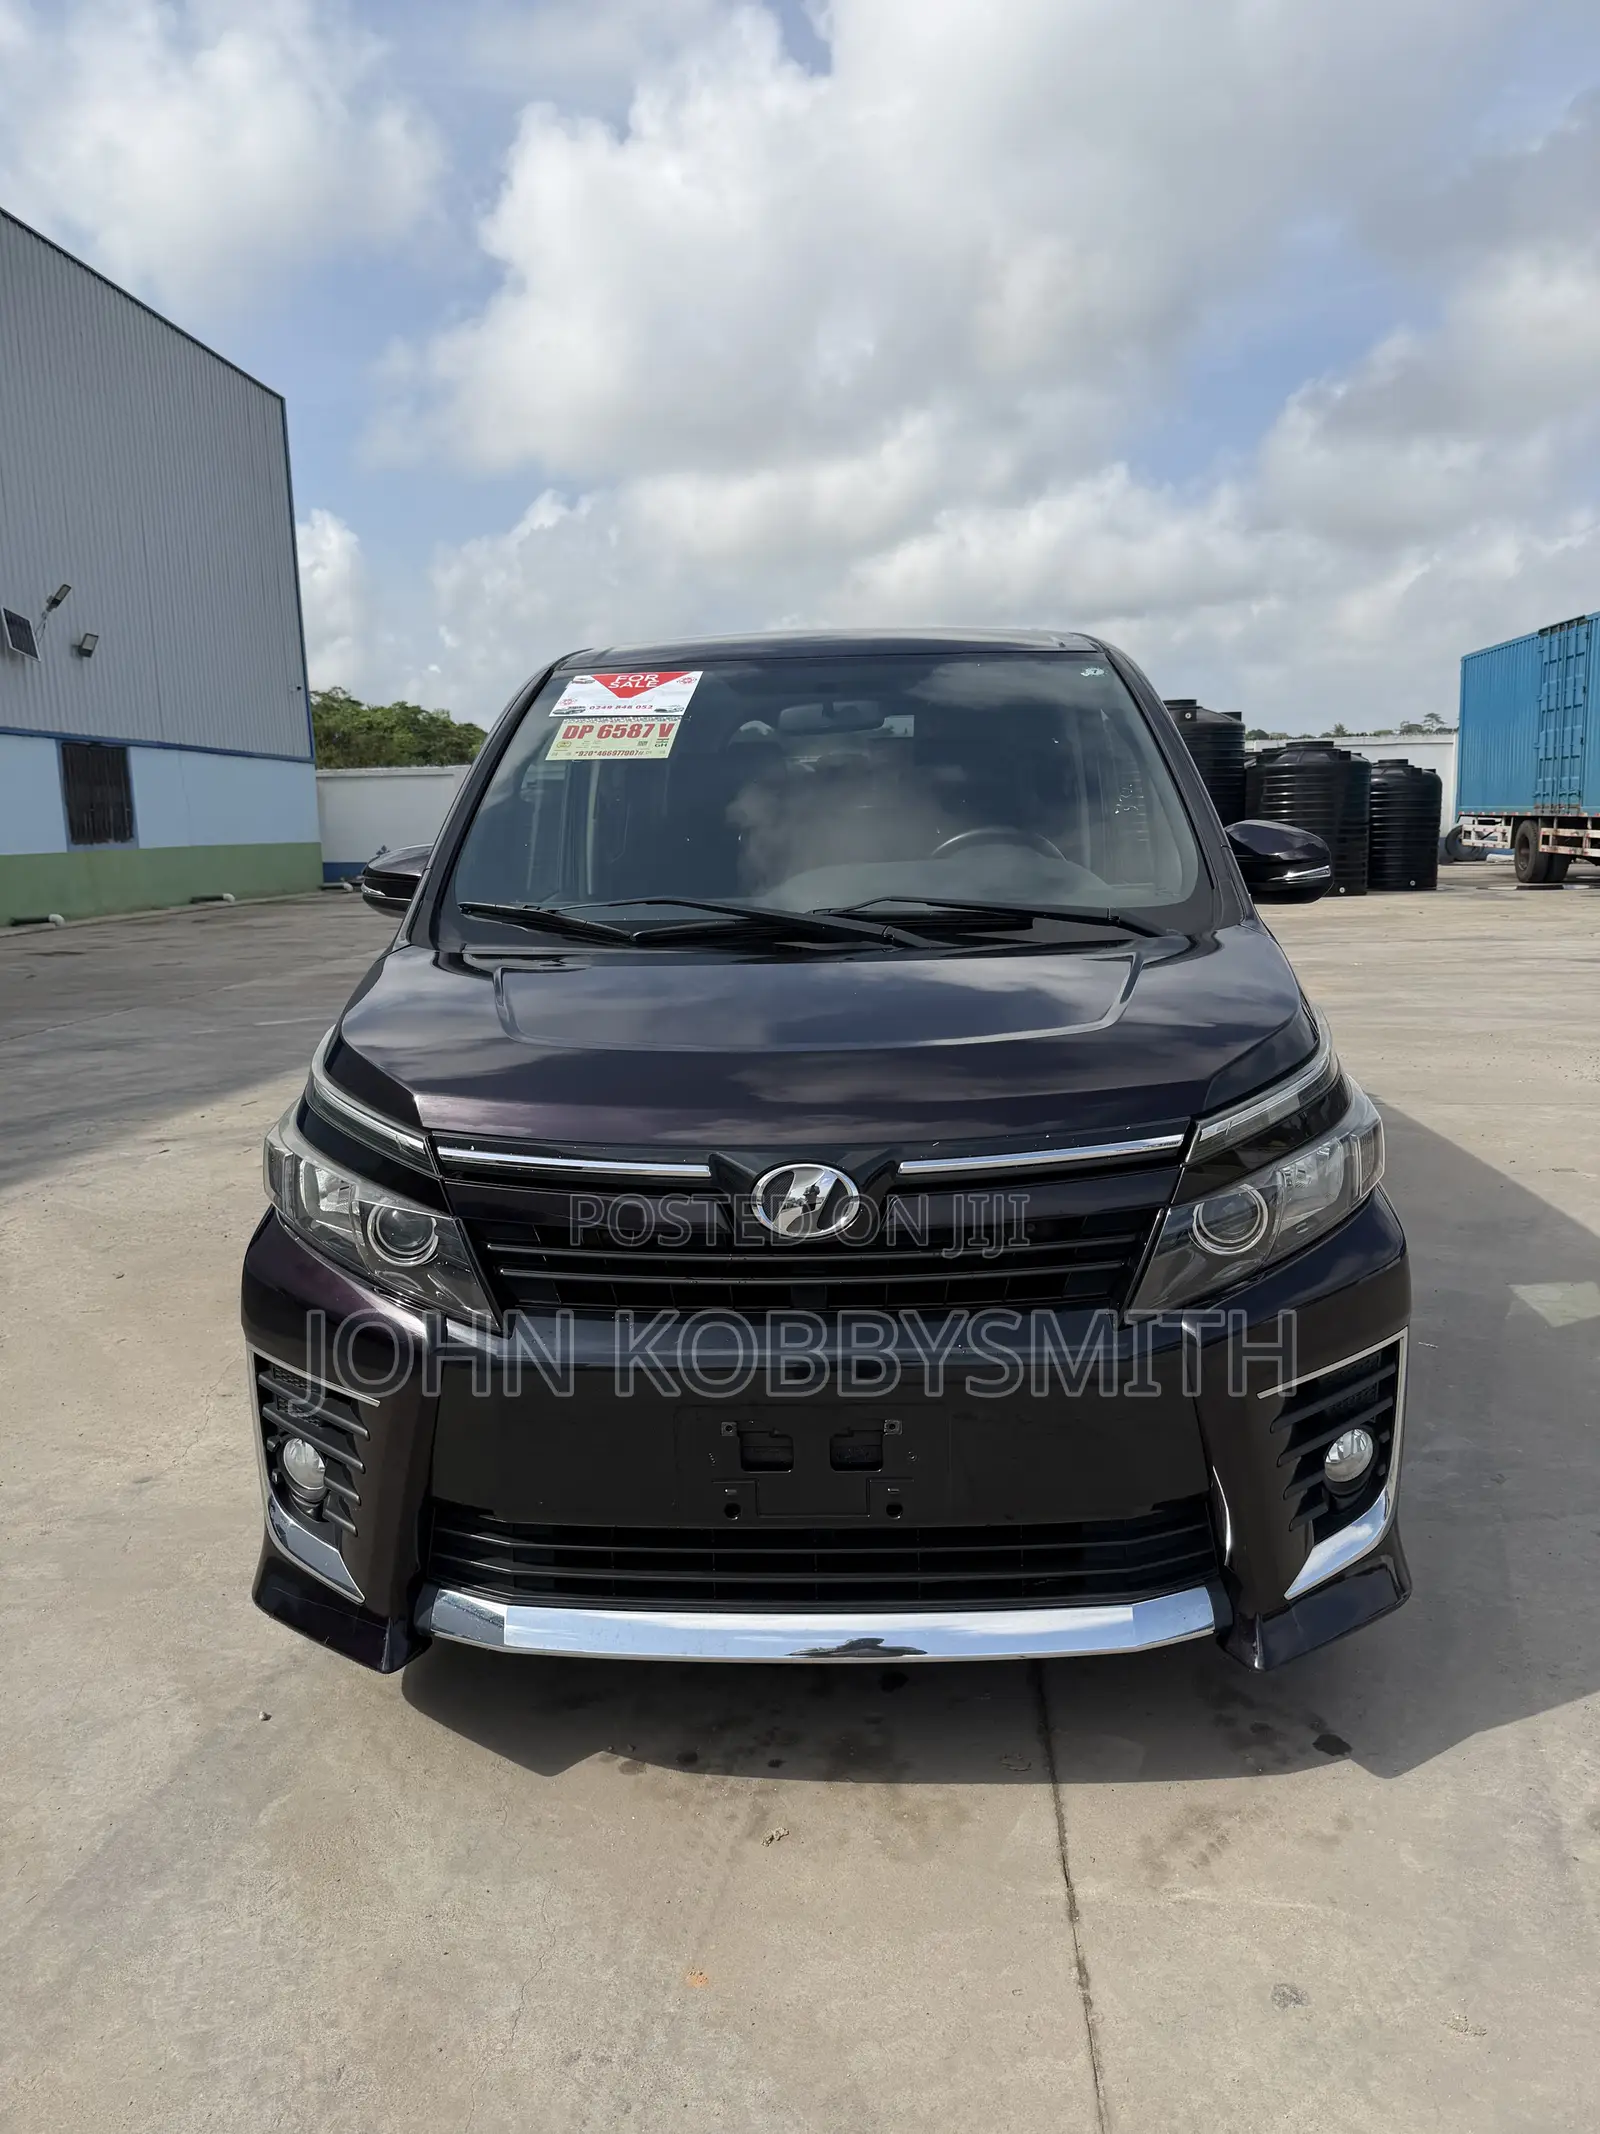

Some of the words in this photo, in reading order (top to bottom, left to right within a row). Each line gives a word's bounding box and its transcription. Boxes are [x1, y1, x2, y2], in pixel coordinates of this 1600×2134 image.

[616, 674, 660, 683] FOR
[608, 681, 660, 689] SALE
[562, 725, 594, 740] DP
[596, 723, 655, 739] 6587
[658, 723, 675, 738] V
